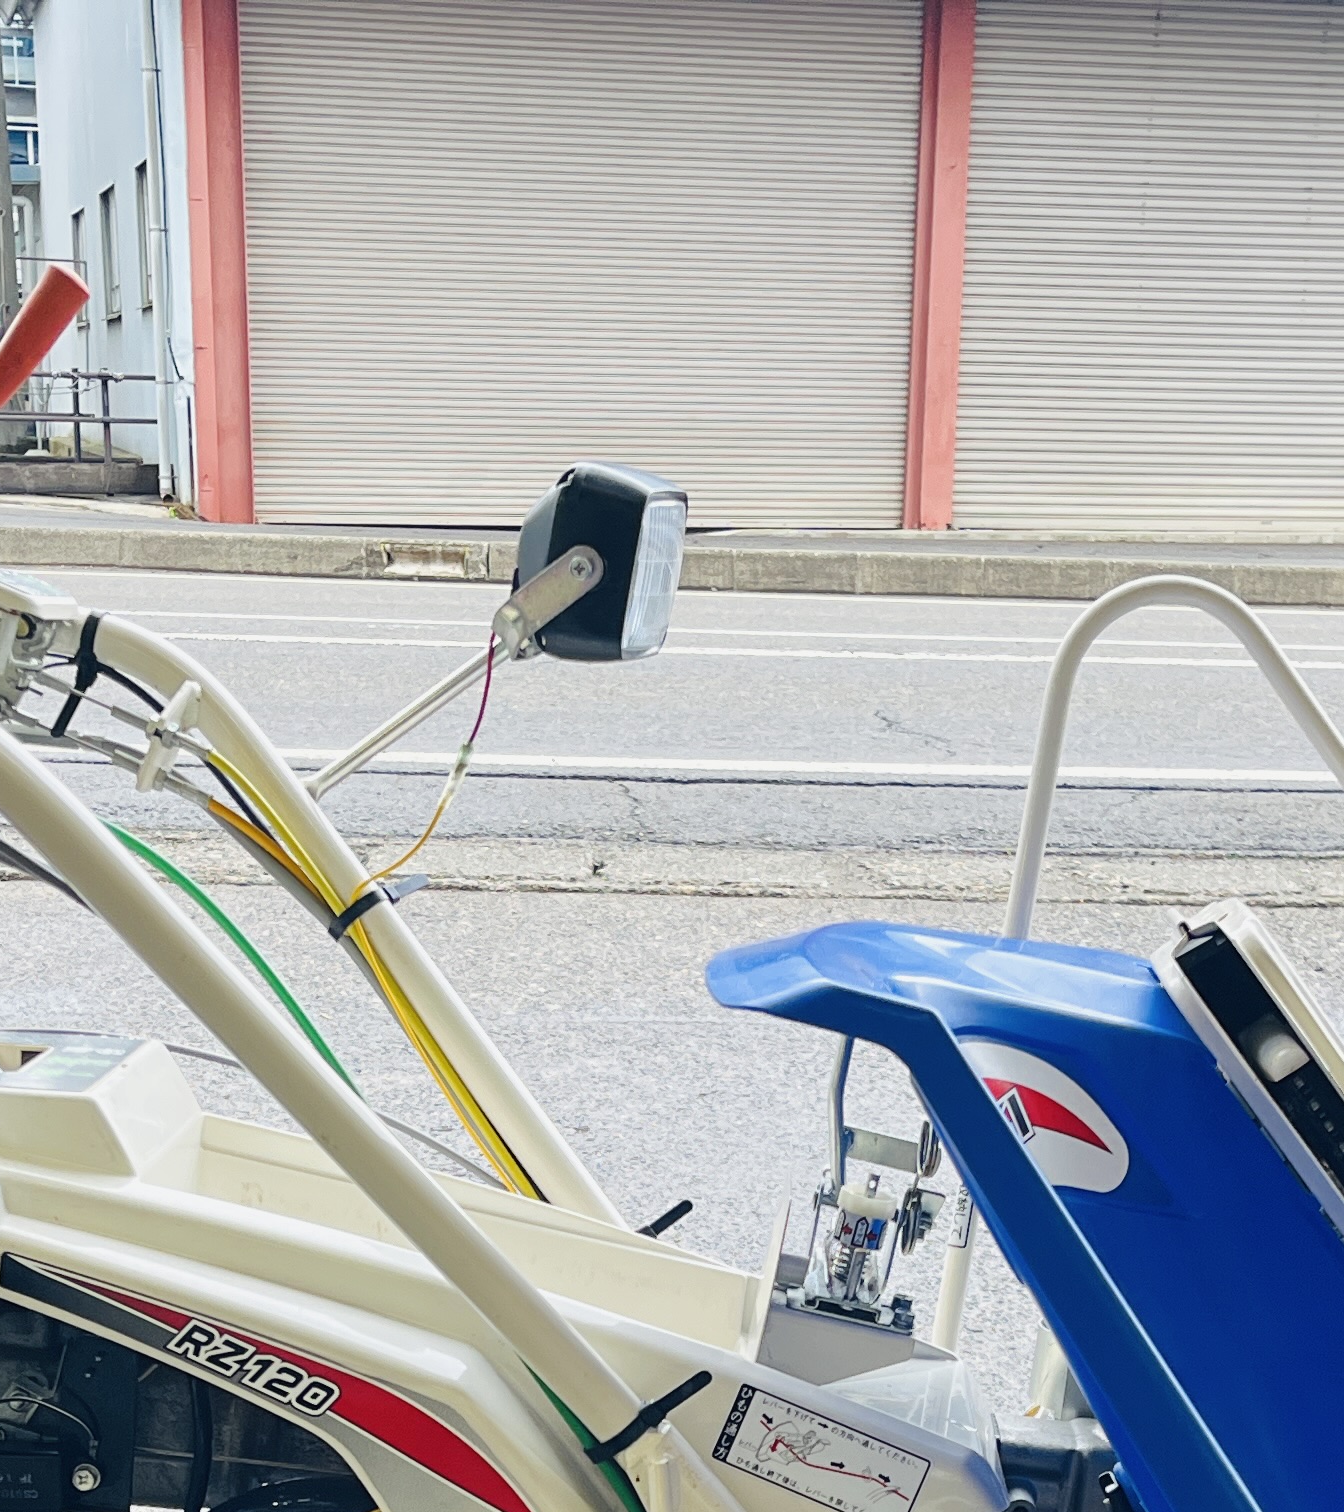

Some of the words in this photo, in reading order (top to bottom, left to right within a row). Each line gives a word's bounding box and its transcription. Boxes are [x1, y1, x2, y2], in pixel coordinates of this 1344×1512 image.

[166, 1319, 339, 1415] RZ120
[714, 1387, 753, 1460] ひもの通し方
